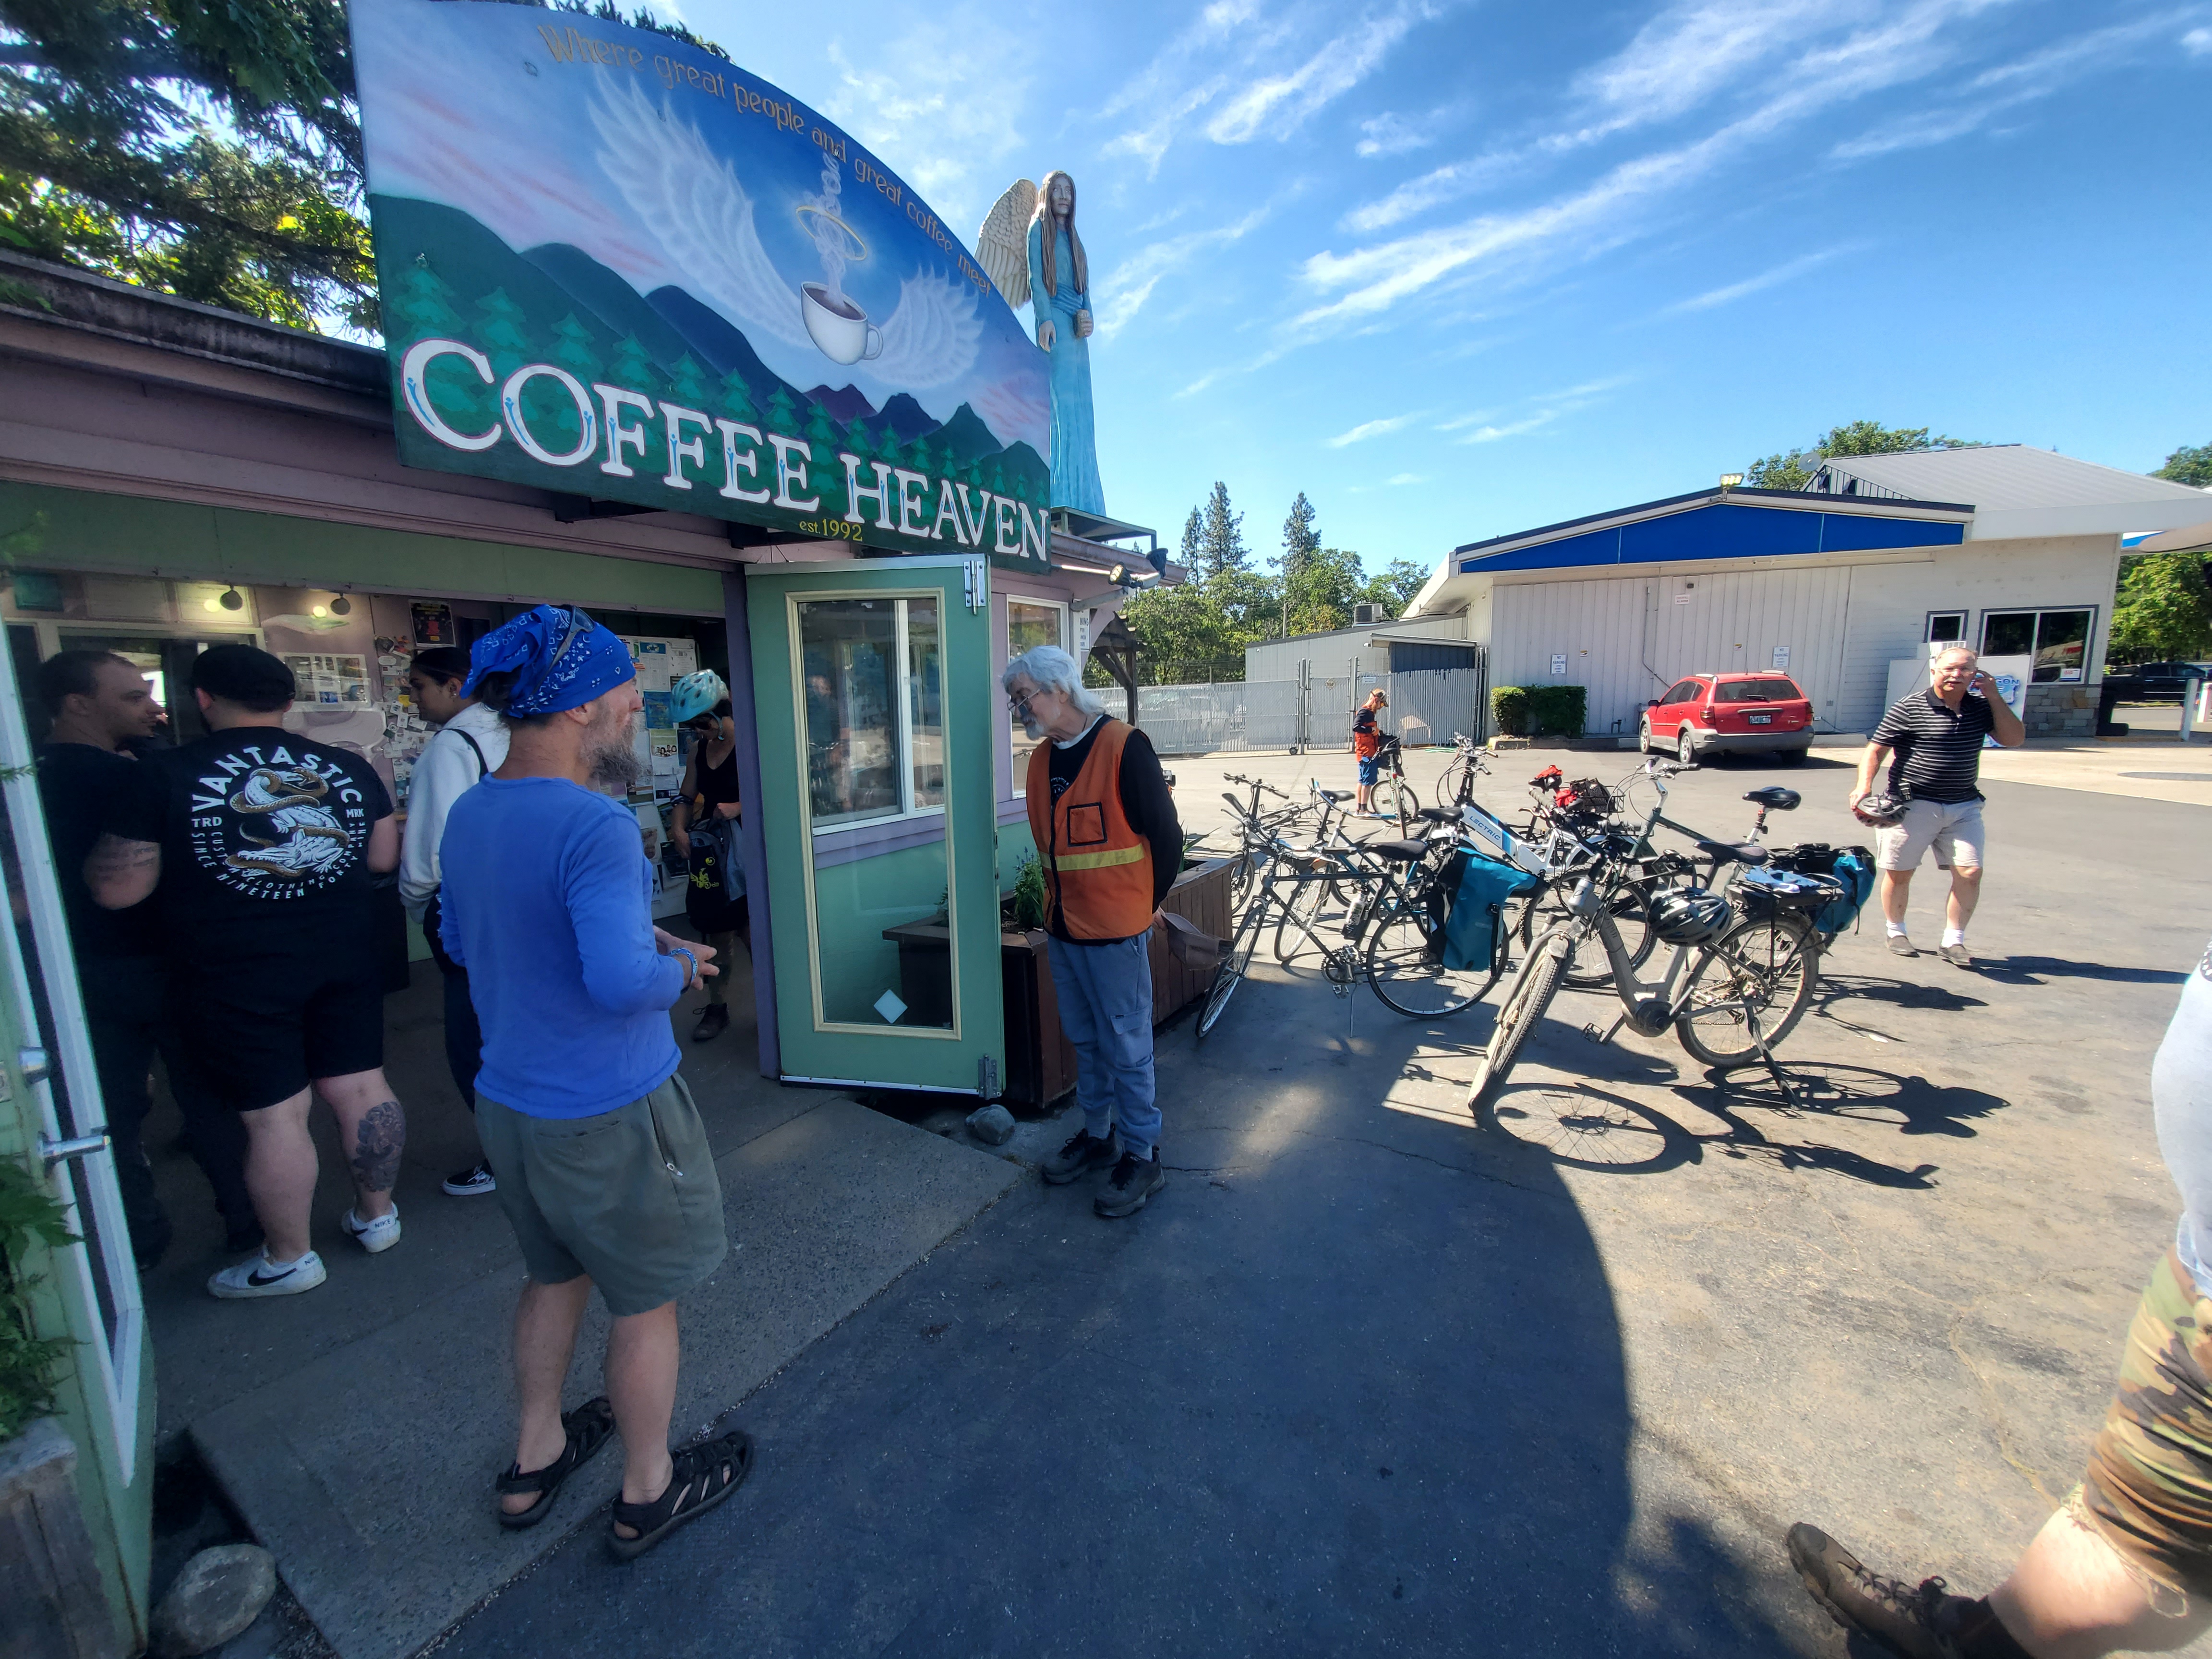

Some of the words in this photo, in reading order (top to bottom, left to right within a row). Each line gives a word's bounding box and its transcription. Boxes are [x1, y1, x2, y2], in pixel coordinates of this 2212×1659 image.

[538, 25, 644, 72] Where
[654, 53, 725, 99] great
[733, 83, 805, 134] people
[811, 127, 847, 164] and
[854, 158, 902, 207] great
[906, 201, 953, 255] coffee
[958, 253, 991, 298] meet
[401, 338, 820, 512] COFFEE
[840, 453, 1049, 562] HEAVEN
[192, 746, 362, 812] VANTASTIC
[191, 817, 222, 828] TRD
[346, 808, 364, 818] MRK
[1469, 816, 1501, 840] LECTRIC
[192, 833, 217, 867] SINCE
[216, 873, 305, 899] NINETEEN
[318, 855, 359, 889] FORTY
[357, 822, 366, 847] NINE
[211, 832, 240, 873] CUSTM
[246, 875, 325, 889] CLOTHING
[333, 823, 357, 869] COMPANY
[375, 1218, 390, 1228] NIKE
